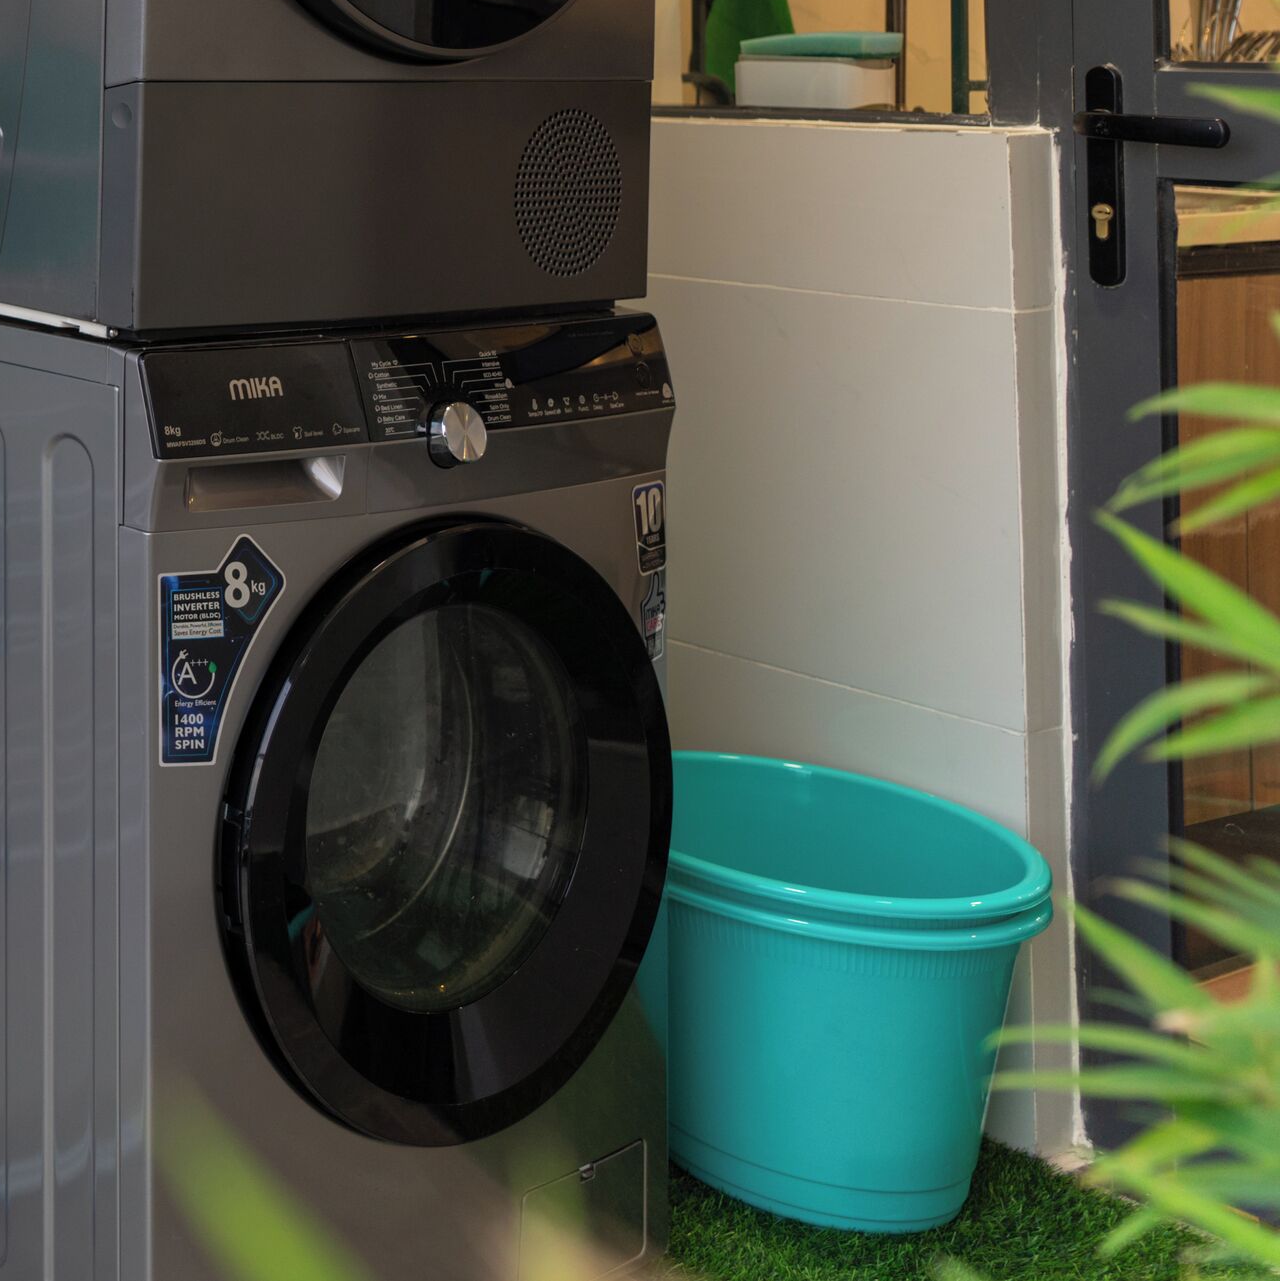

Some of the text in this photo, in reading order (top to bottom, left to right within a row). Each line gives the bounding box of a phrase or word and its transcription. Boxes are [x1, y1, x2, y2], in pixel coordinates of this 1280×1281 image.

[229, 375, 284, 400] MIKA
[164, 424, 181, 437] 8kg
[270, 432, 285, 440] BLDC
[222, 435, 249, 445] Drum Clean
[636, 487, 662, 536] 10
[173, 591, 220, 601] BRUSHLESS
[173, 601, 220, 612] INVERTER
[174, 611, 221, 621] MOTOR (BLDC)
[189, 628, 207, 637] Energy
[174, 699, 217, 709] Energy Efficient
[175, 713, 204, 725] 1400
[175, 726, 204, 738] RPM
[175, 738, 205, 750] SPIN
